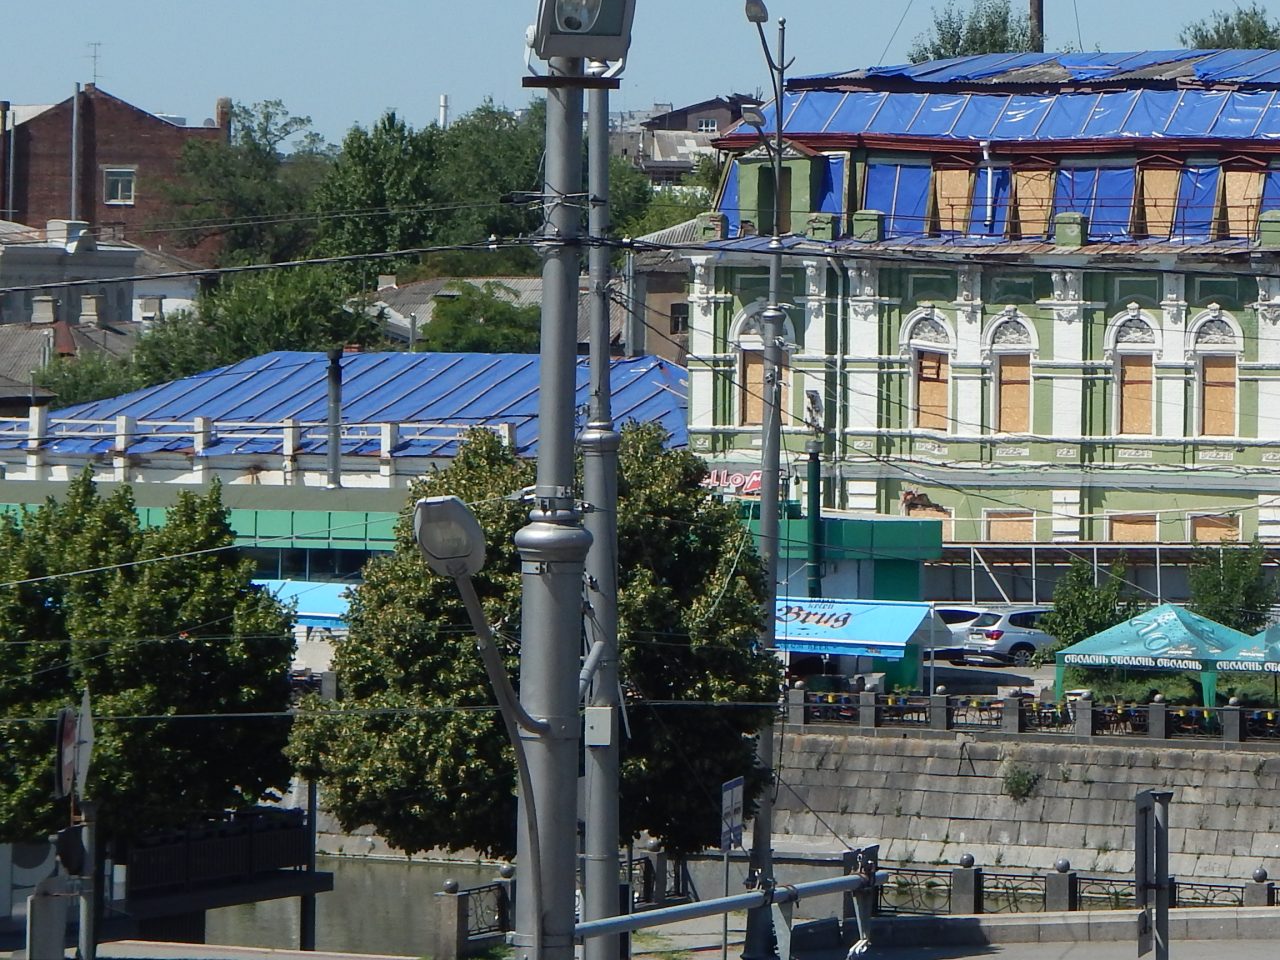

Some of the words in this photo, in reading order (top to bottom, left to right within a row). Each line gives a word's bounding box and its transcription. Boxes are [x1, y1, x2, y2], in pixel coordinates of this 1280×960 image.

[776, 606, 853, 628] Brug
[1064, 654, 1109, 664] ОБОЛОНЬ
[1110, 655, 1155, 667] ОБОЛОНЬ
[1156, 658, 1203, 671] ОБОЛОНЬ
[1216, 661, 1262, 671] ОБОЛОНЬ
